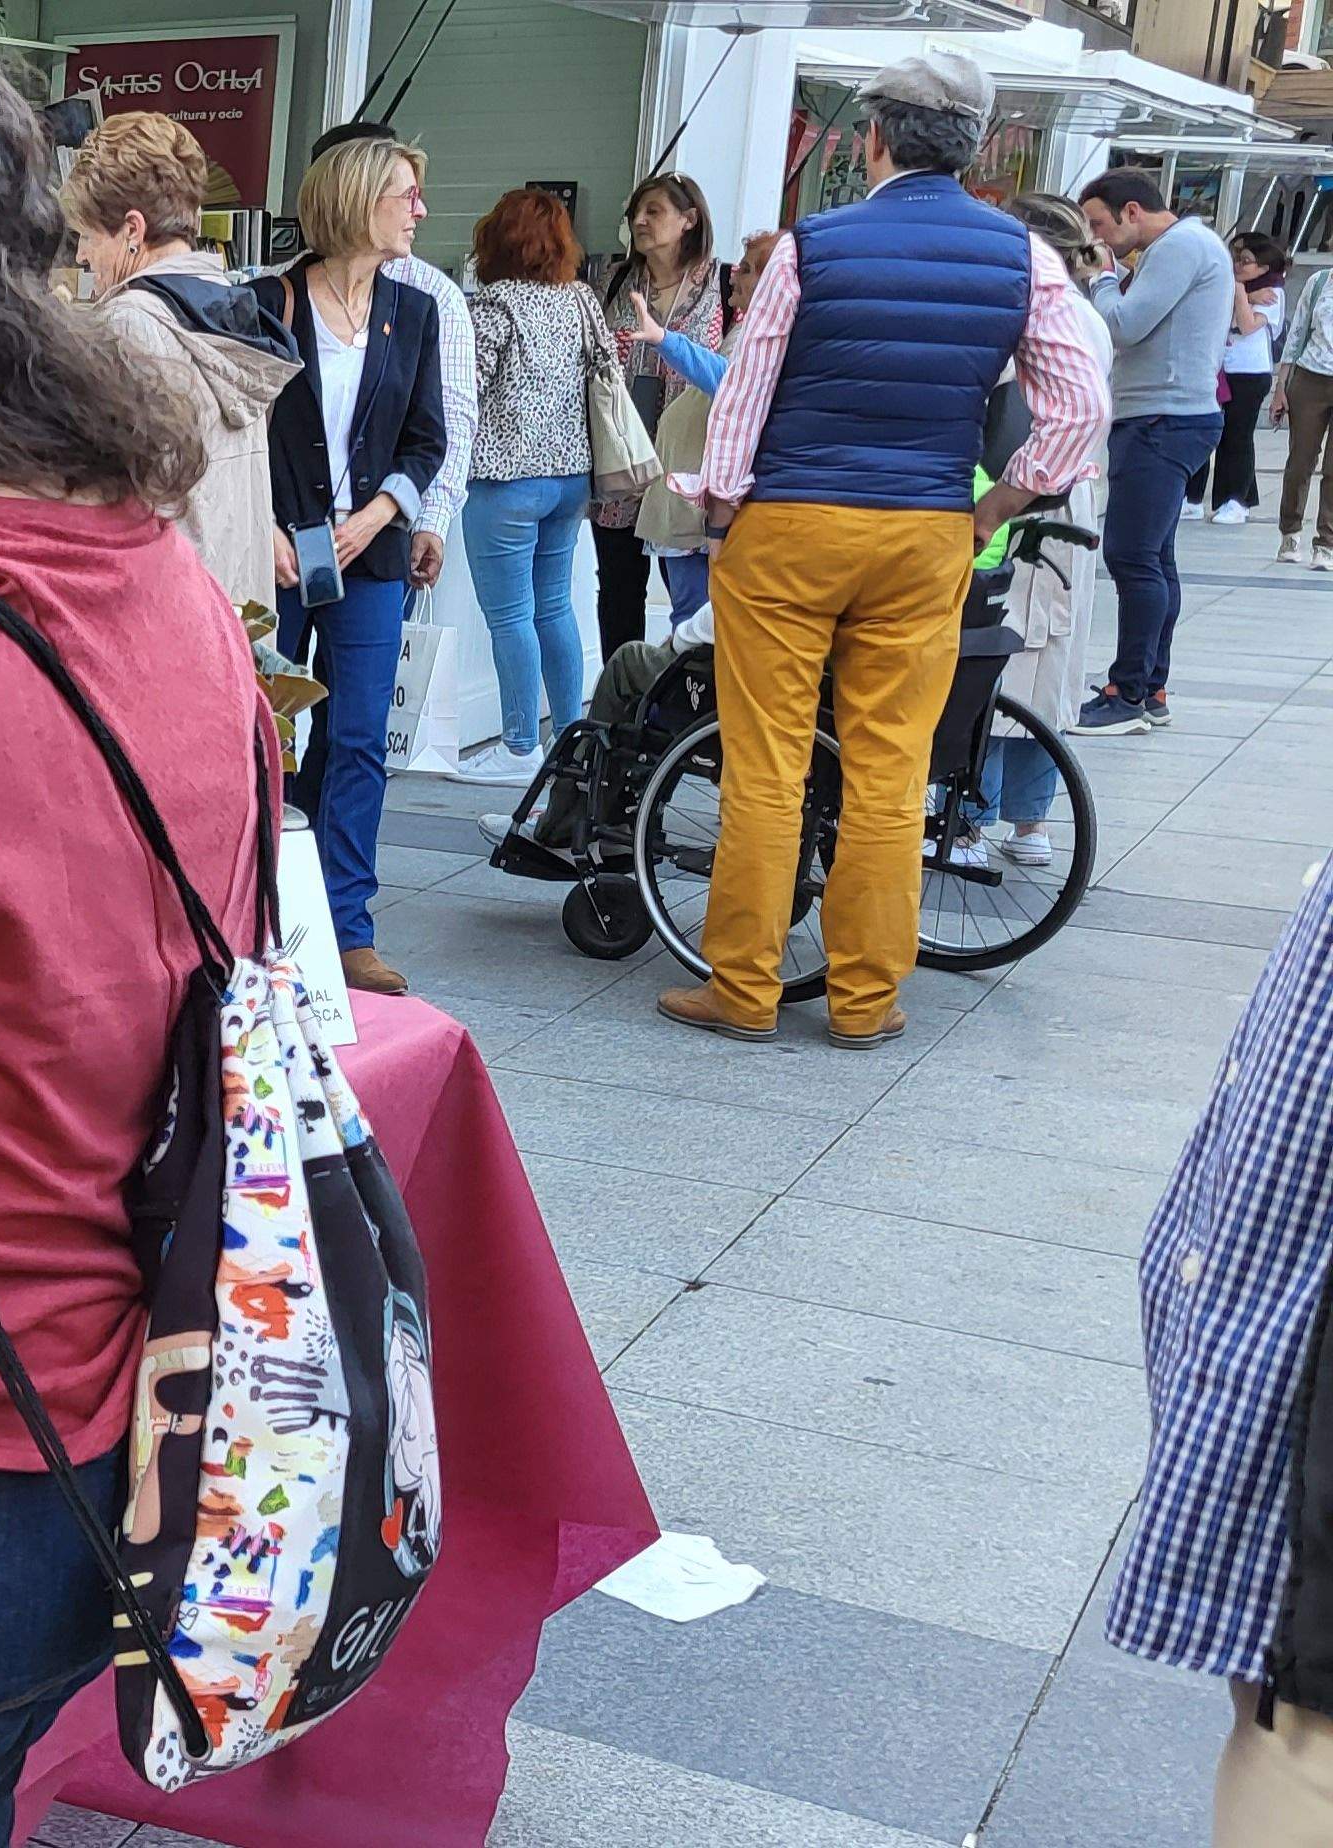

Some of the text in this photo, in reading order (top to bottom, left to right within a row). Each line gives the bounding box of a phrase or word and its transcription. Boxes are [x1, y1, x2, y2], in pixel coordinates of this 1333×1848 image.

[209, 111, 216, 122] y
[218, 109, 243, 119] ocio
[386, 731, 409, 756] SCA
